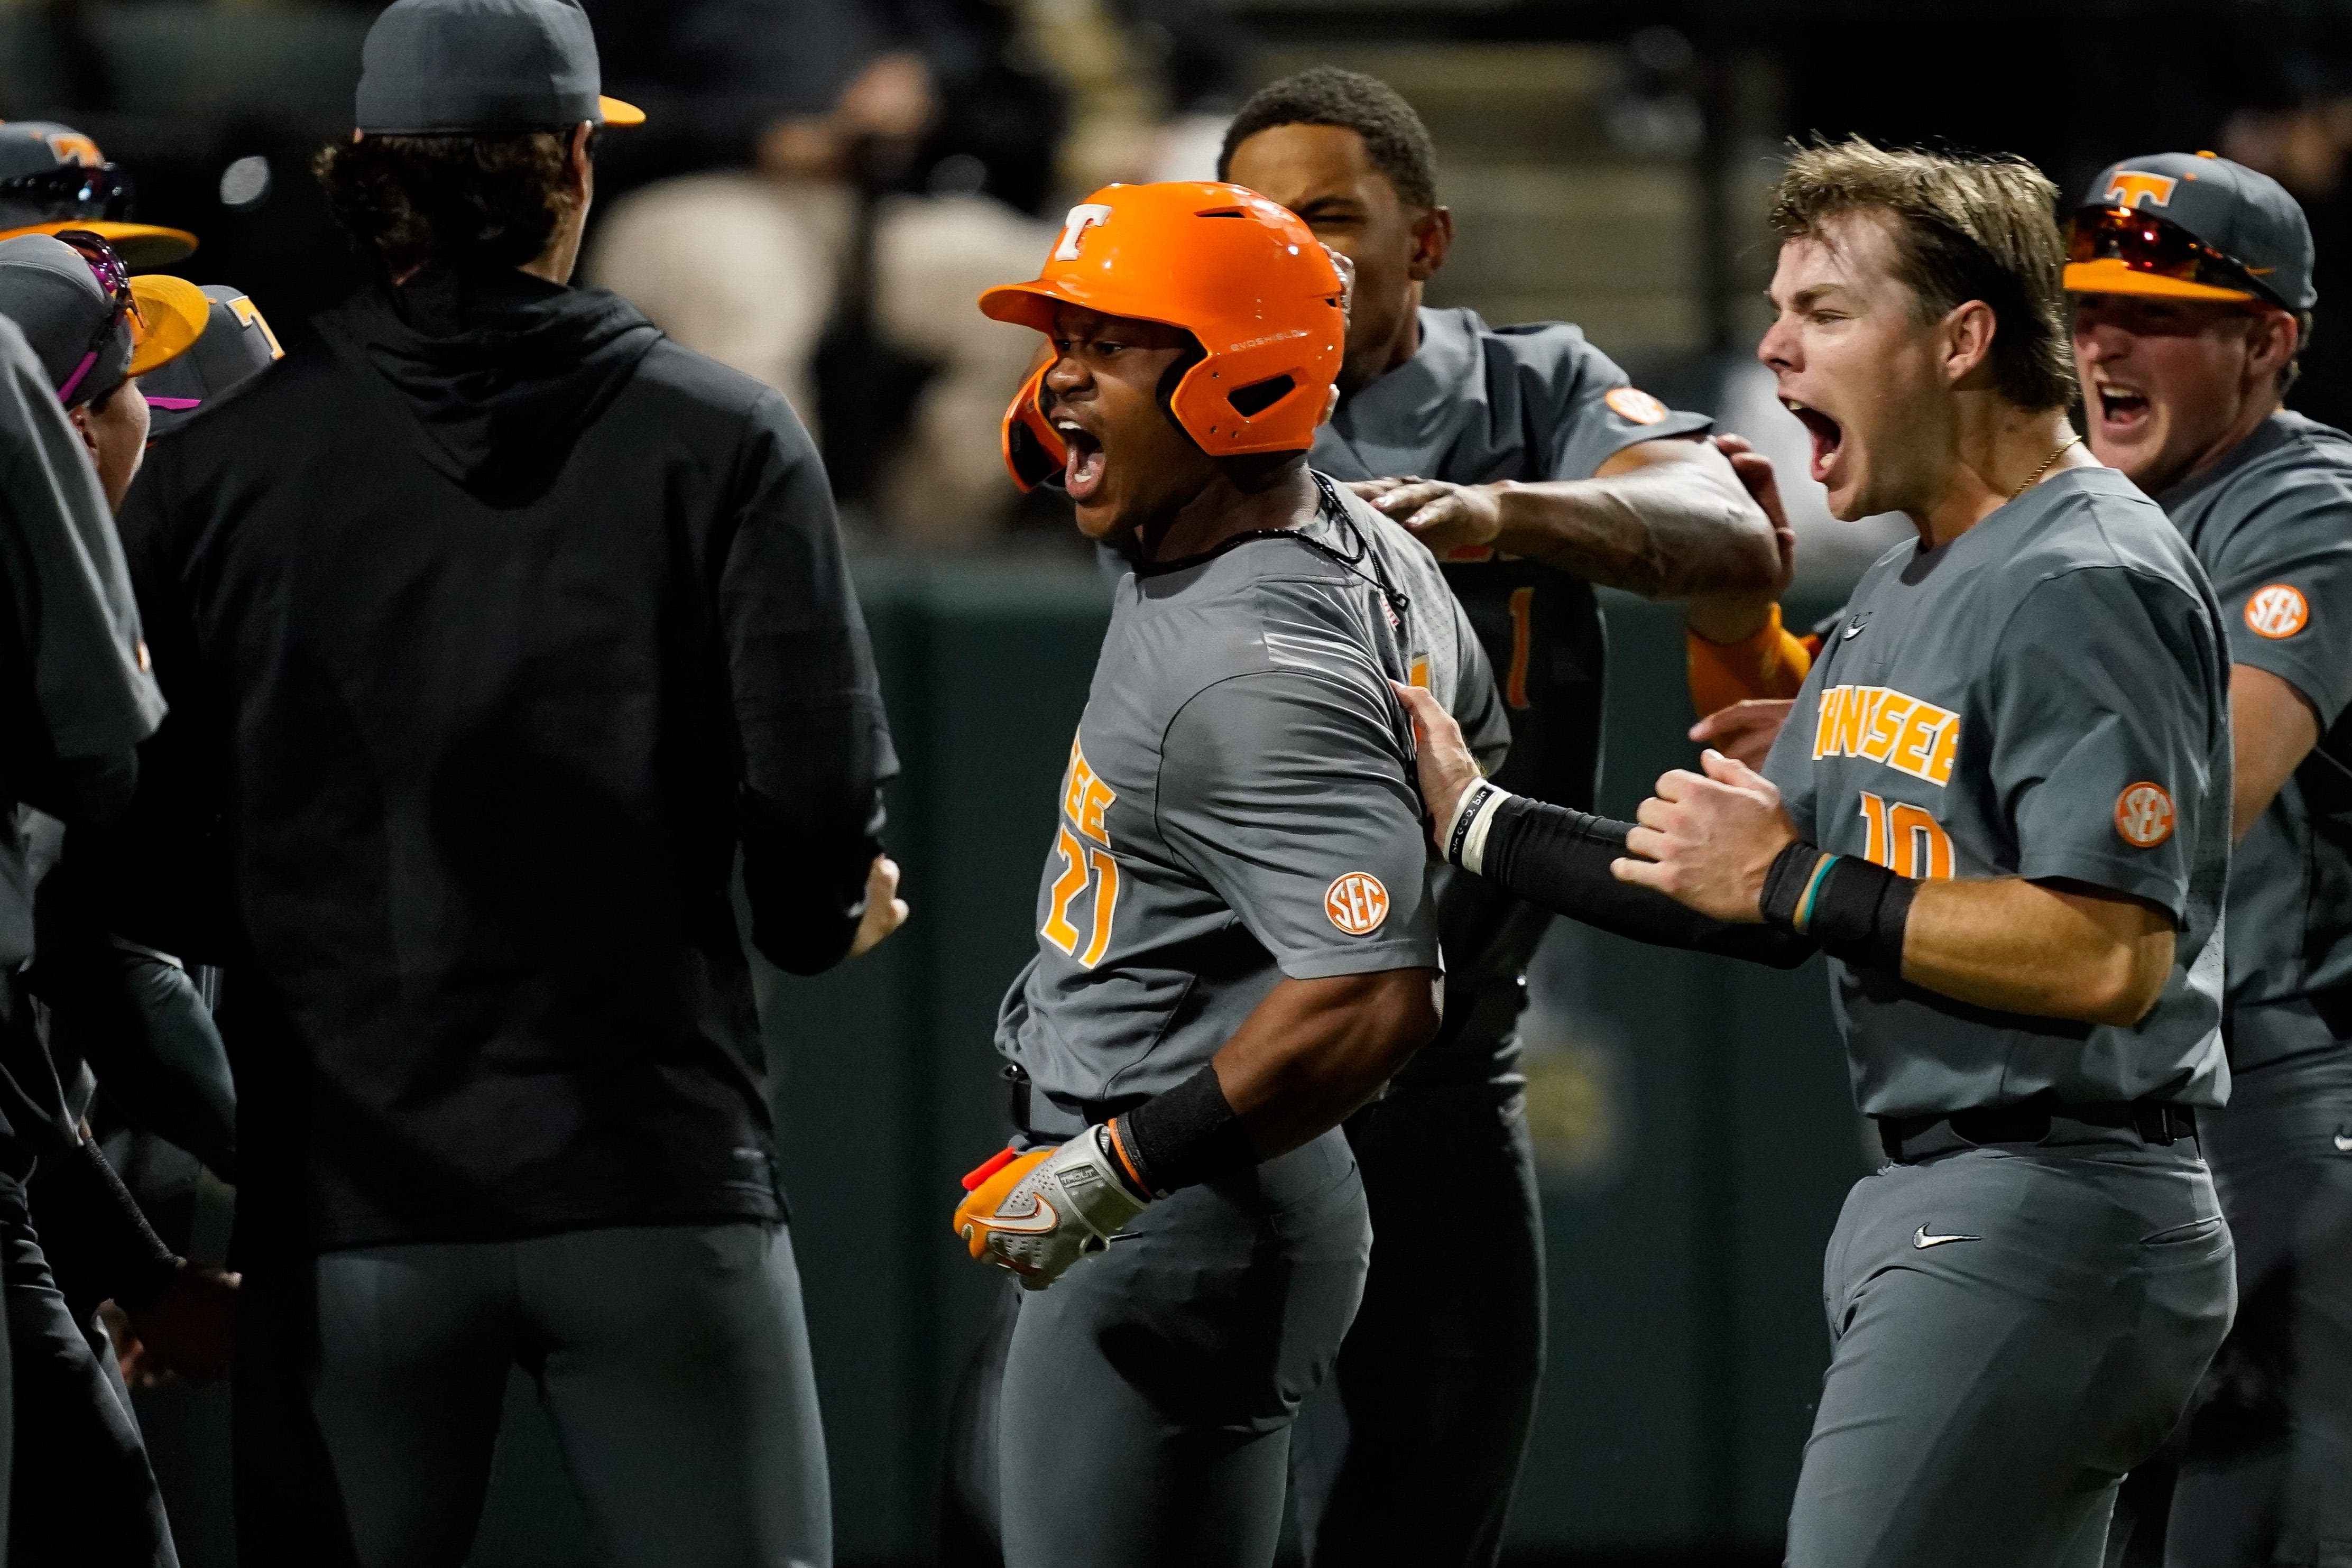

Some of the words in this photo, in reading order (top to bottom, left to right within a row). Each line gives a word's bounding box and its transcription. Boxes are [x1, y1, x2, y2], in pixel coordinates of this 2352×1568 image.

[1054, 203, 1113, 262] T
[2248, 587, 2301, 634] SEC
[1064, 723, 1118, 849] EE
[2122, 787, 2171, 842] SEC
[1859, 790, 1956, 881] 10
[1040, 822, 1120, 970] 21
[1330, 877, 1383, 930] SEC
